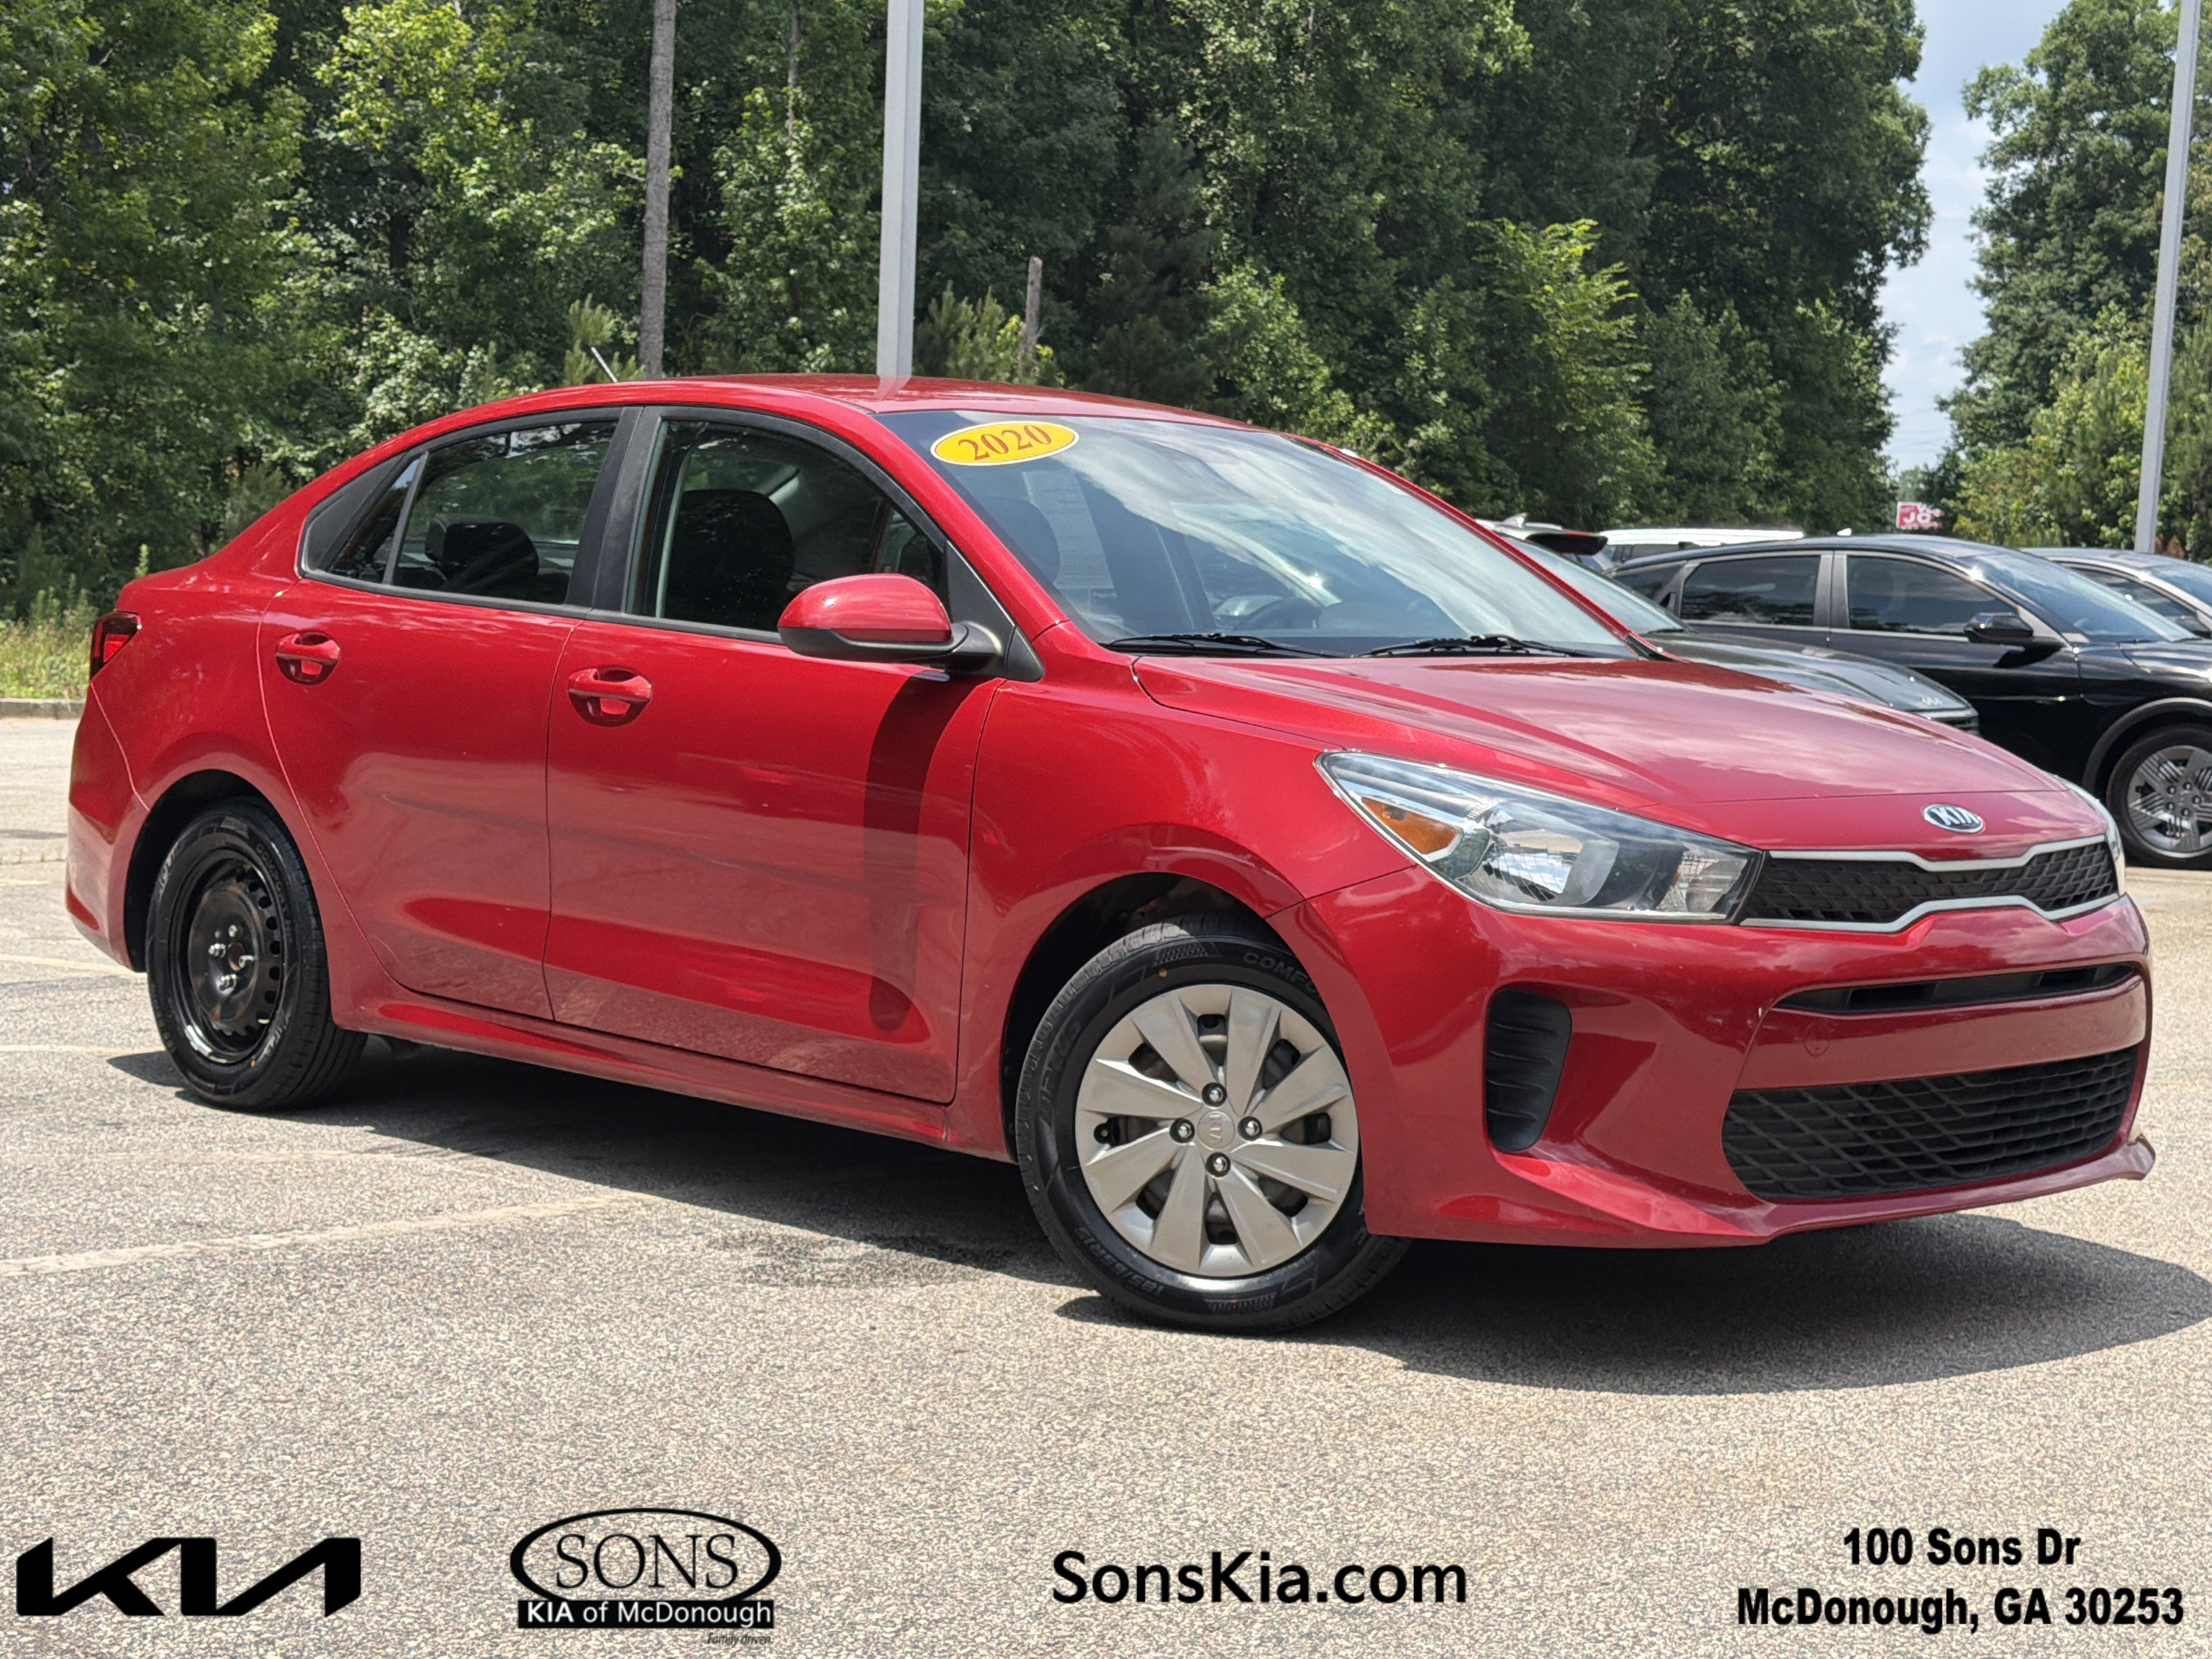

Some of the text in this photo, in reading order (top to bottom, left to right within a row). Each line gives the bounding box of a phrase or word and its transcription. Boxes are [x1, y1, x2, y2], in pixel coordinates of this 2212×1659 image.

[957, 424, 1052, 461] 2020
[1929, 806, 1979, 826] KIA
[1243, 952, 1317, 994] COMFO
